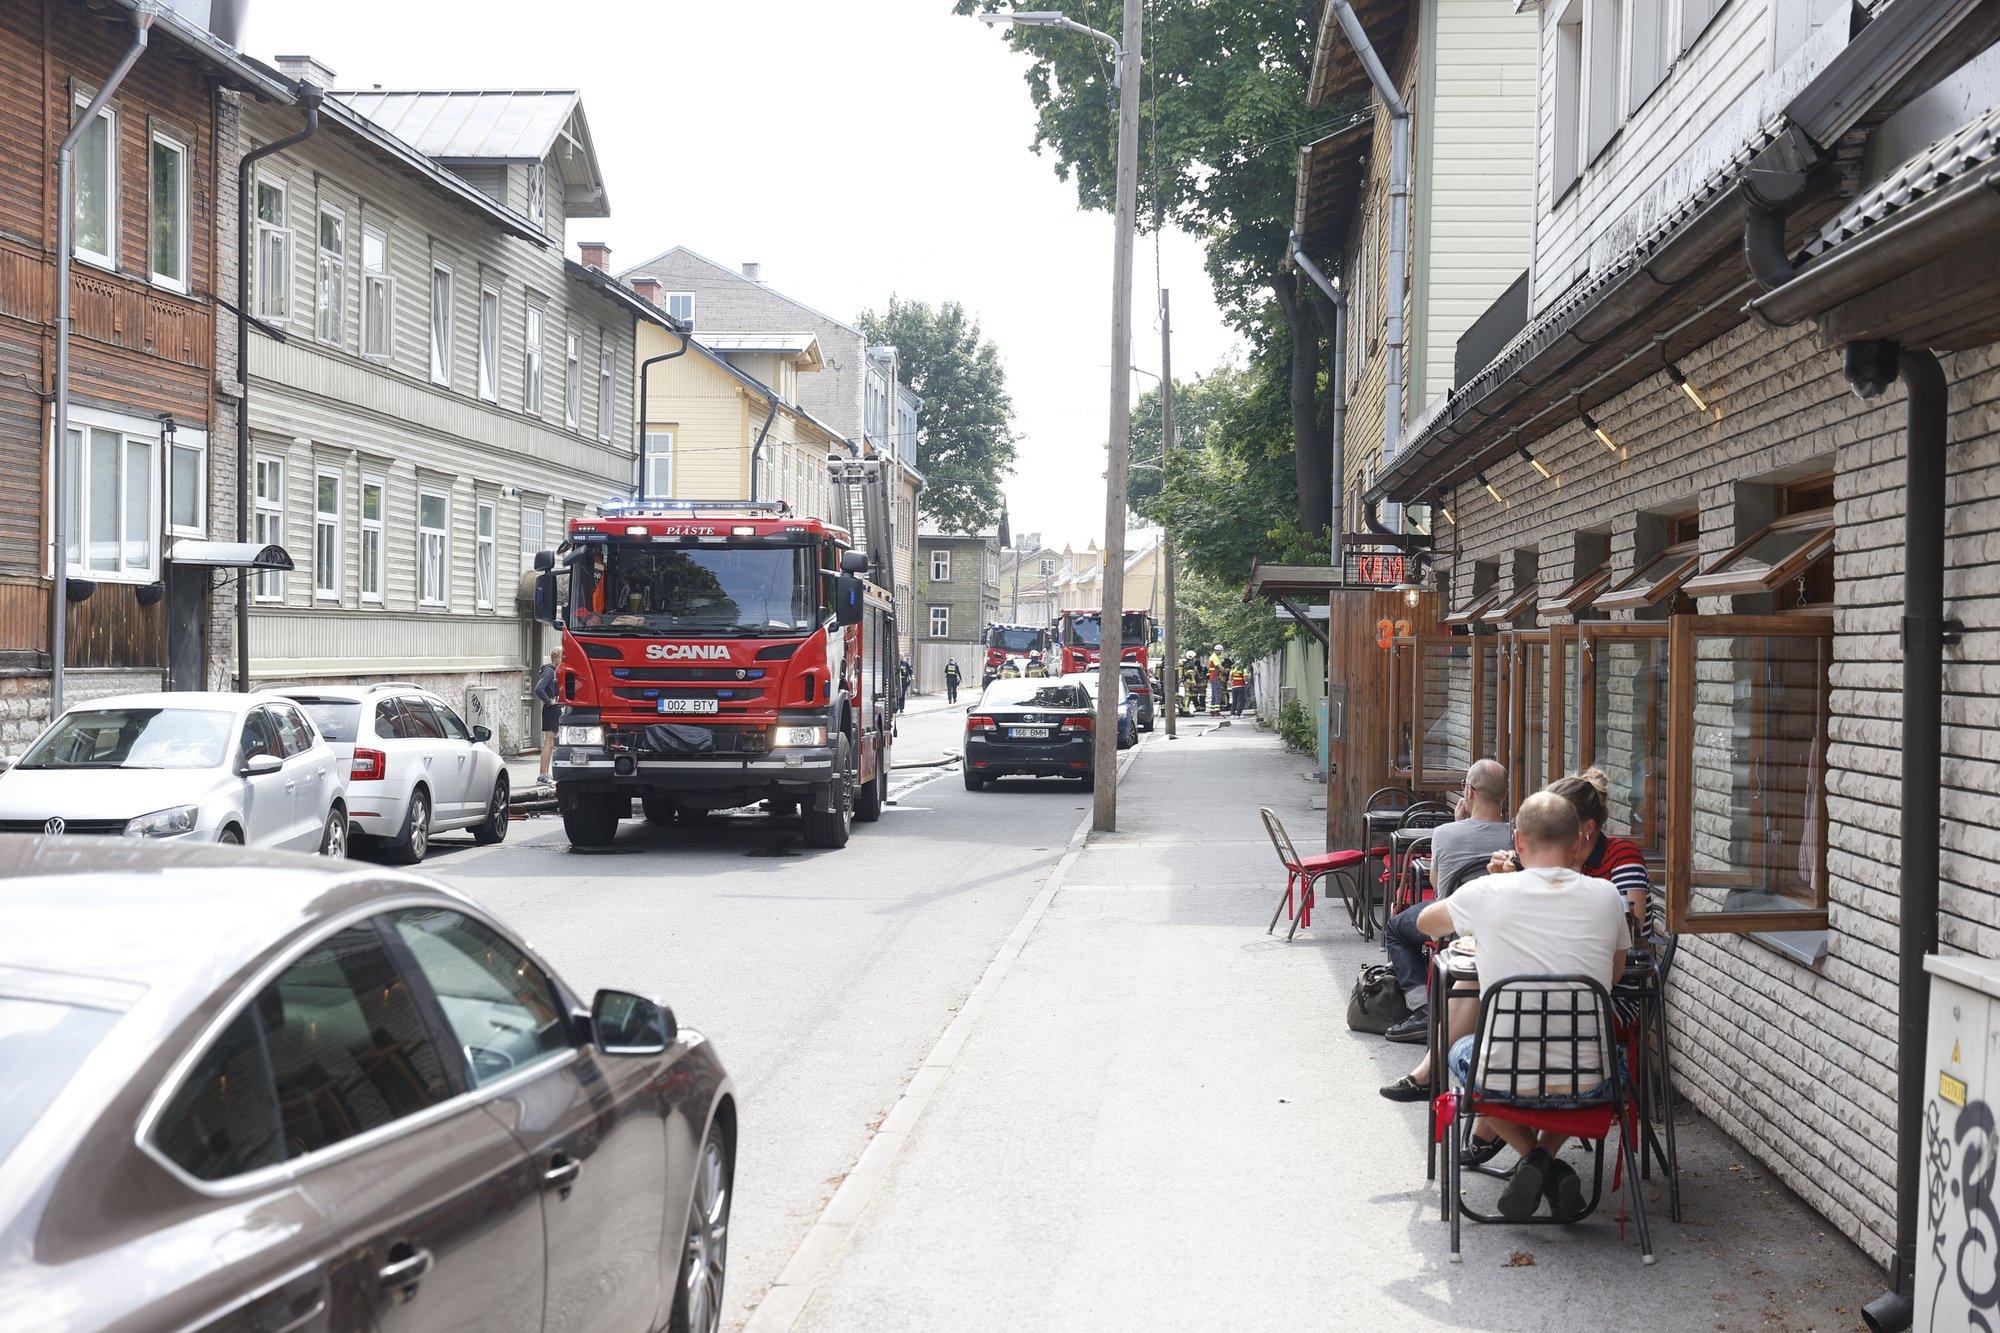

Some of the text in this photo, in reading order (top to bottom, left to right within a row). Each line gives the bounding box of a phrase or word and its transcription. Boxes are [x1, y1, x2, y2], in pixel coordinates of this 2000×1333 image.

[665, 525, 715, 535] PÄÄSTE
[645, 644, 731, 660] SCANIA
[667, 700, 714, 711] 002 BTY
